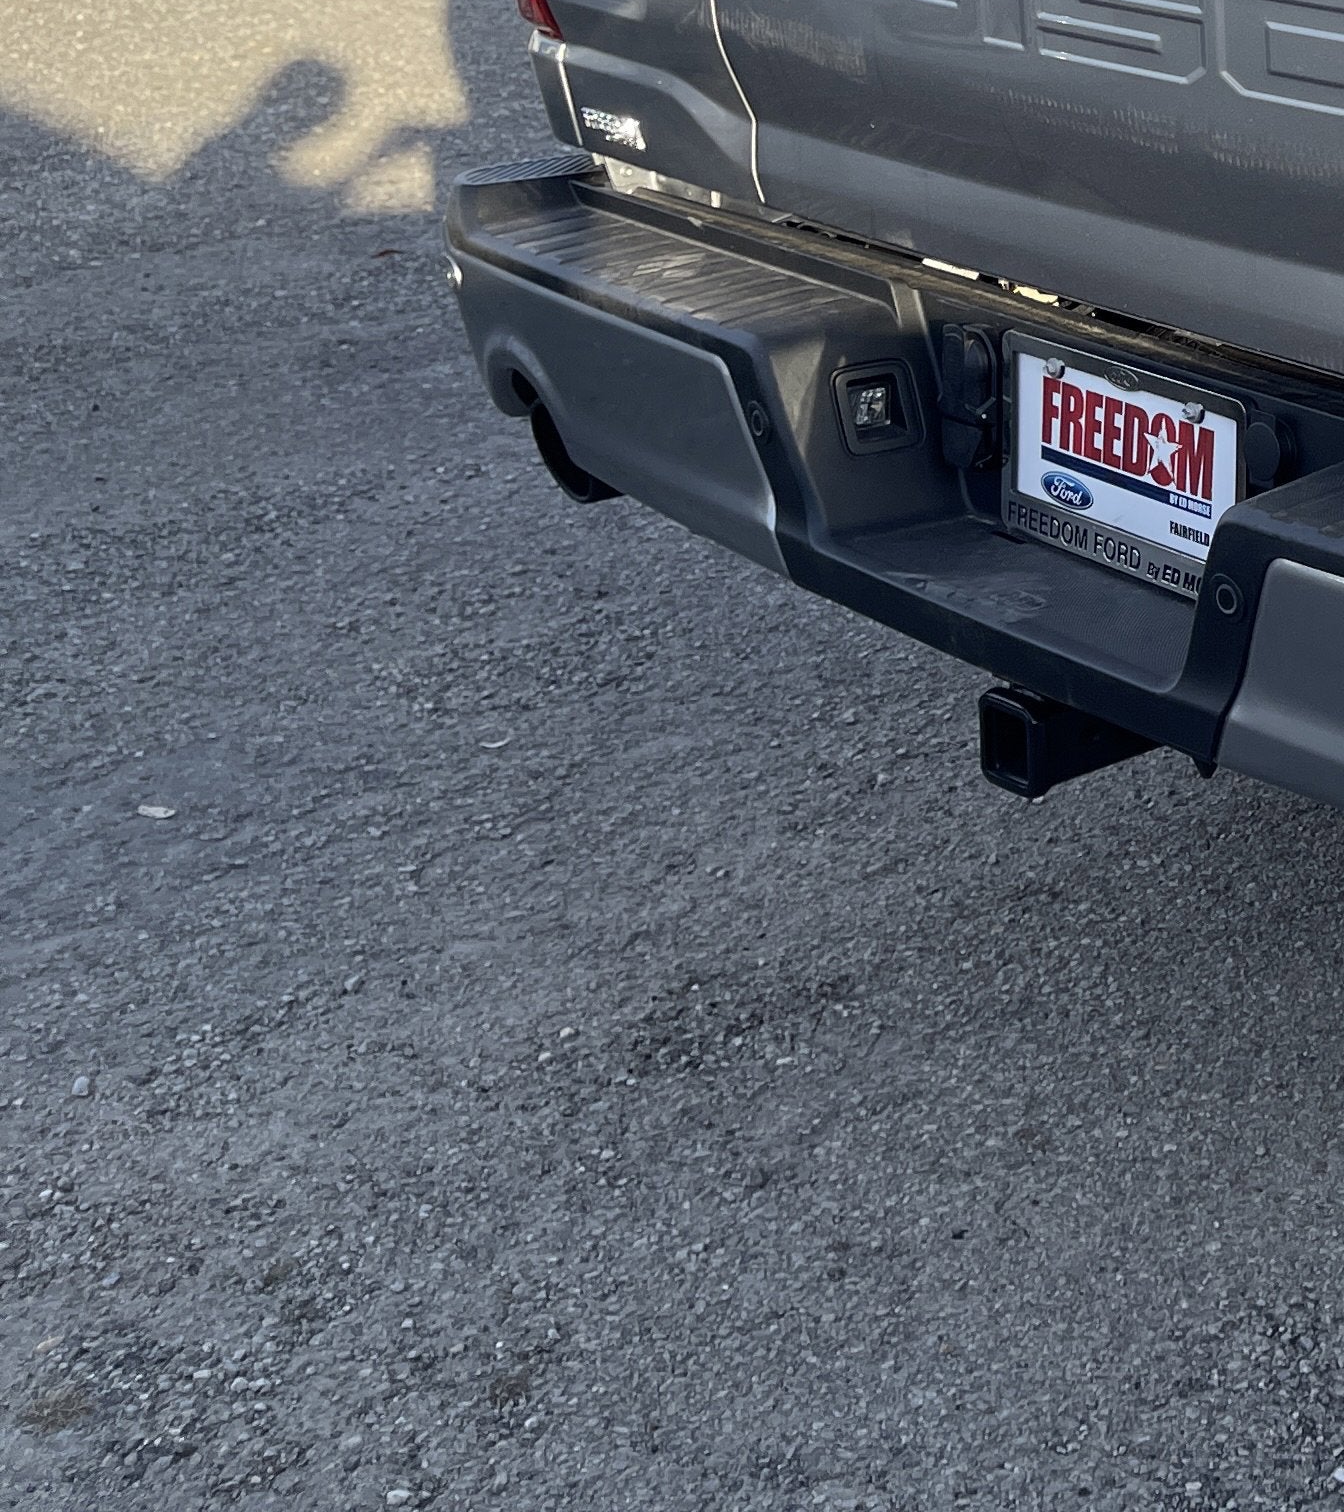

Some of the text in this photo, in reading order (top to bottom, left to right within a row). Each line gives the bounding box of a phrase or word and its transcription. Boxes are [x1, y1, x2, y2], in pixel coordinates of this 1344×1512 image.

[1041, 375, 1215, 501] FREEDOM
[1050, 475, 1084, 506] Ford
[1007, 500, 1089, 550] FREEDOM
[1093, 531, 1141, 570] FORD
[1161, 563, 1181, 588] ED
[1169, 519, 1210, 547] FAIRFIELD
